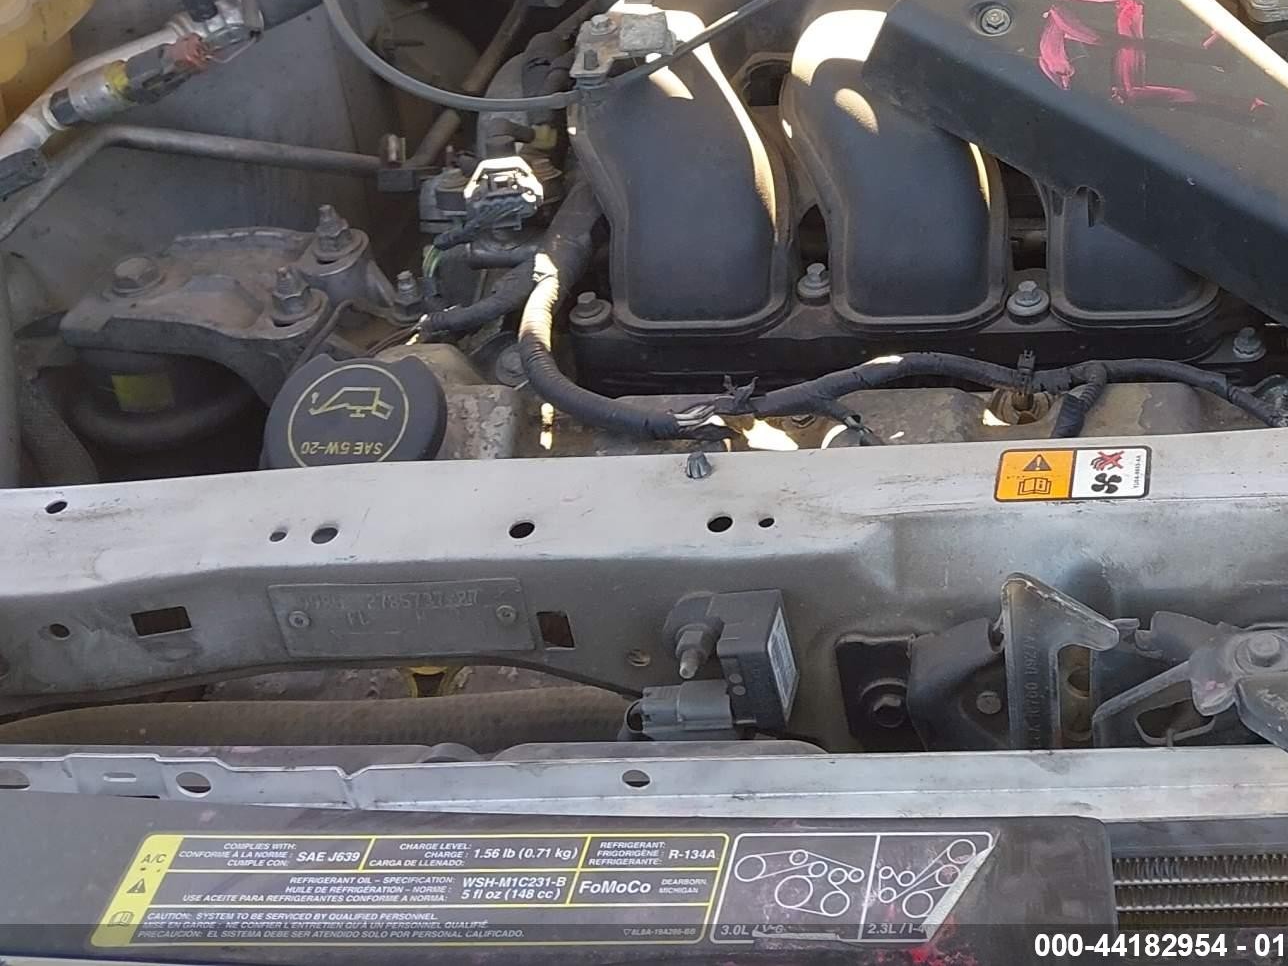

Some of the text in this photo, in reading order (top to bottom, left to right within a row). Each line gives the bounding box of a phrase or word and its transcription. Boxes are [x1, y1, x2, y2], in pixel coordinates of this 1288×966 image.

[301, 441, 383, 455] SAE 5W-20
[223, 842, 270, 850] COMPLIES
[399, 842, 437, 850] CHARGE
[599, 841, 666, 849] REFRIGERANT:
[179, 850, 230, 858] CONFORME
[296, 851, 360, 862] SAE J639
[424, 851, 464, 859] CHARGE
[473, 847, 578, 860] 1.56 lb (0.71 kg)
[668, 849, 717, 860] R-134A
[141, 853, 167, 864] A/C
[226, 859, 265, 867] CUMPLE
[368, 859, 402, 867] CARGA
[403, 859, 417, 867] DE
[289, 876, 356, 884] REFRIGERANT
[356, 876, 372, 884] OIL
[463, 876, 567, 888] WSH-M1C231-B
[284, 885, 313, 894] HUILE
[314, 886, 329, 894] DE
[578, 879, 652, 894] FoMoCo
[182, 894, 202, 902] USE
[202, 894, 239, 902] ACEITE
[239, 894, 264, 902] PARA
[265, 894, 344, 902] REFRIGERANTES
[345, 894, 400, 902] CONFORME
[461, 889, 471, 900] 5
[472, 888, 482, 899] fl
[484, 890, 502, 899] oz
[504, 888, 532, 901] (148
[195, 912, 234, 920] SYSTEM
[236, 912, 249, 920] TO
[250, 912, 263, 920] BE
[265, 912, 312, 920] SERVICED
[313, 912, 328, 920] BY
[328, 912, 378, 920] QUALIFIED
[720, 924, 749, 936] 3.0L
[867, 922, 897, 934] 2.3L
[206, 930, 218, 938] EL
[290, 930, 311, 938] SER
[389, 930, 410, 938] POR
